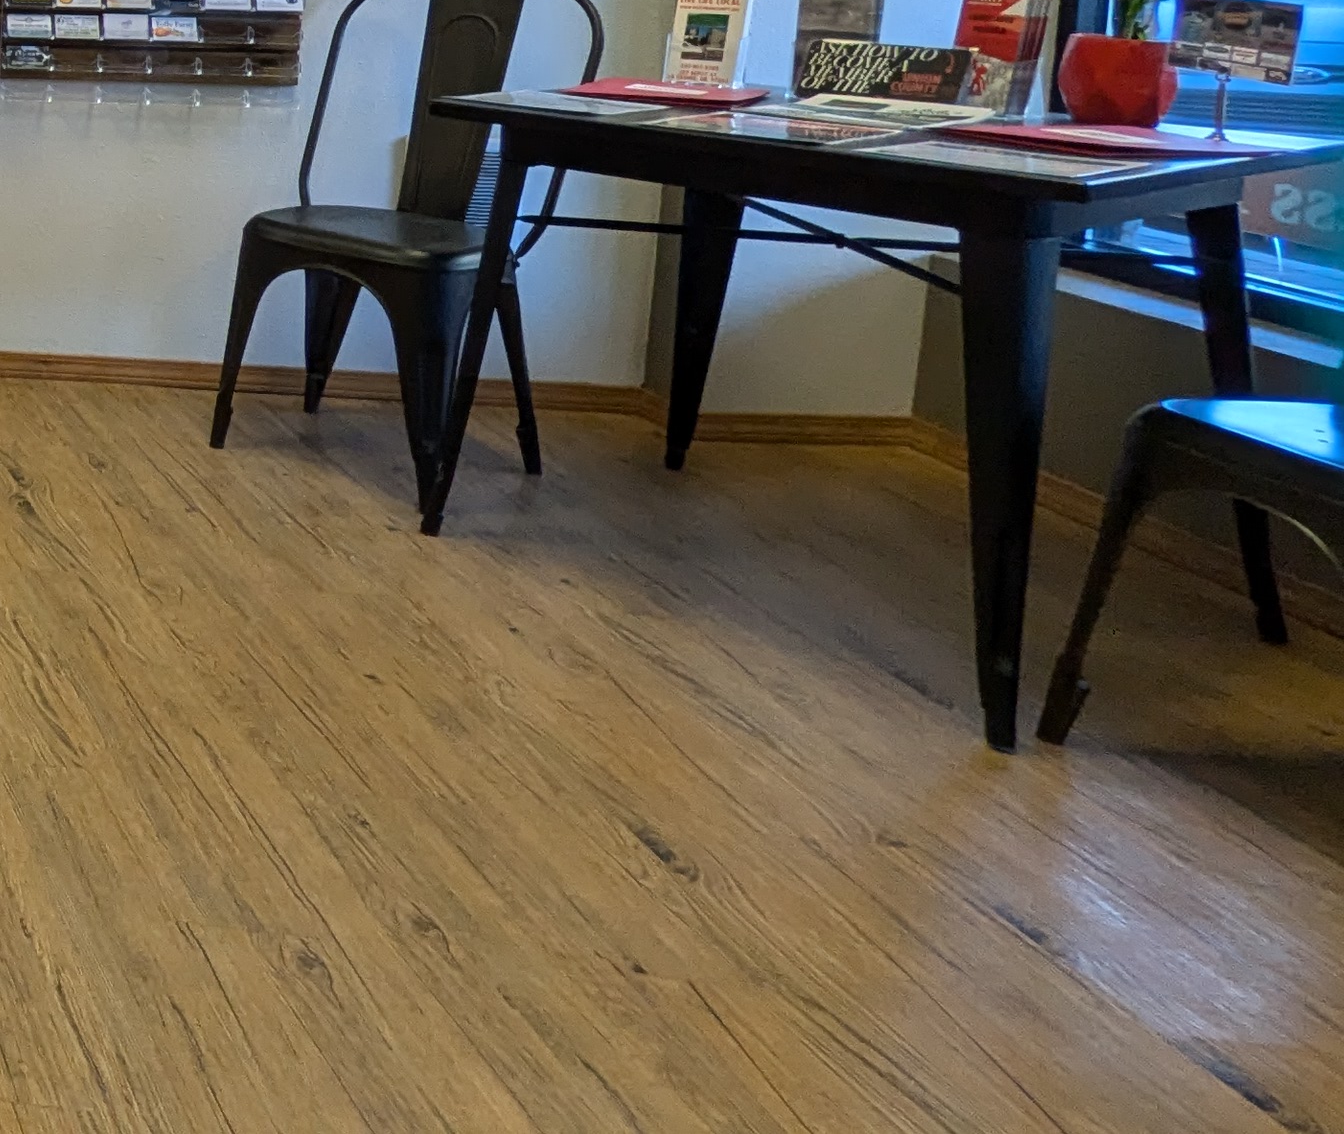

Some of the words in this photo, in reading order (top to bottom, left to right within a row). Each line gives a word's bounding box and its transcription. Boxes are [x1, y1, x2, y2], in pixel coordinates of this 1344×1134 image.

[851, 43, 901, 58] HOW
[906, 48, 940, 62] TO
[808, 53, 892, 72] BECOME
[894, 60, 909, 72] A
[804, 63, 895, 83] MEMBER
[801, 76, 831, 89] OF
[833, 77, 874, 94] THE
[890, 81, 940, 93] COUNTY
